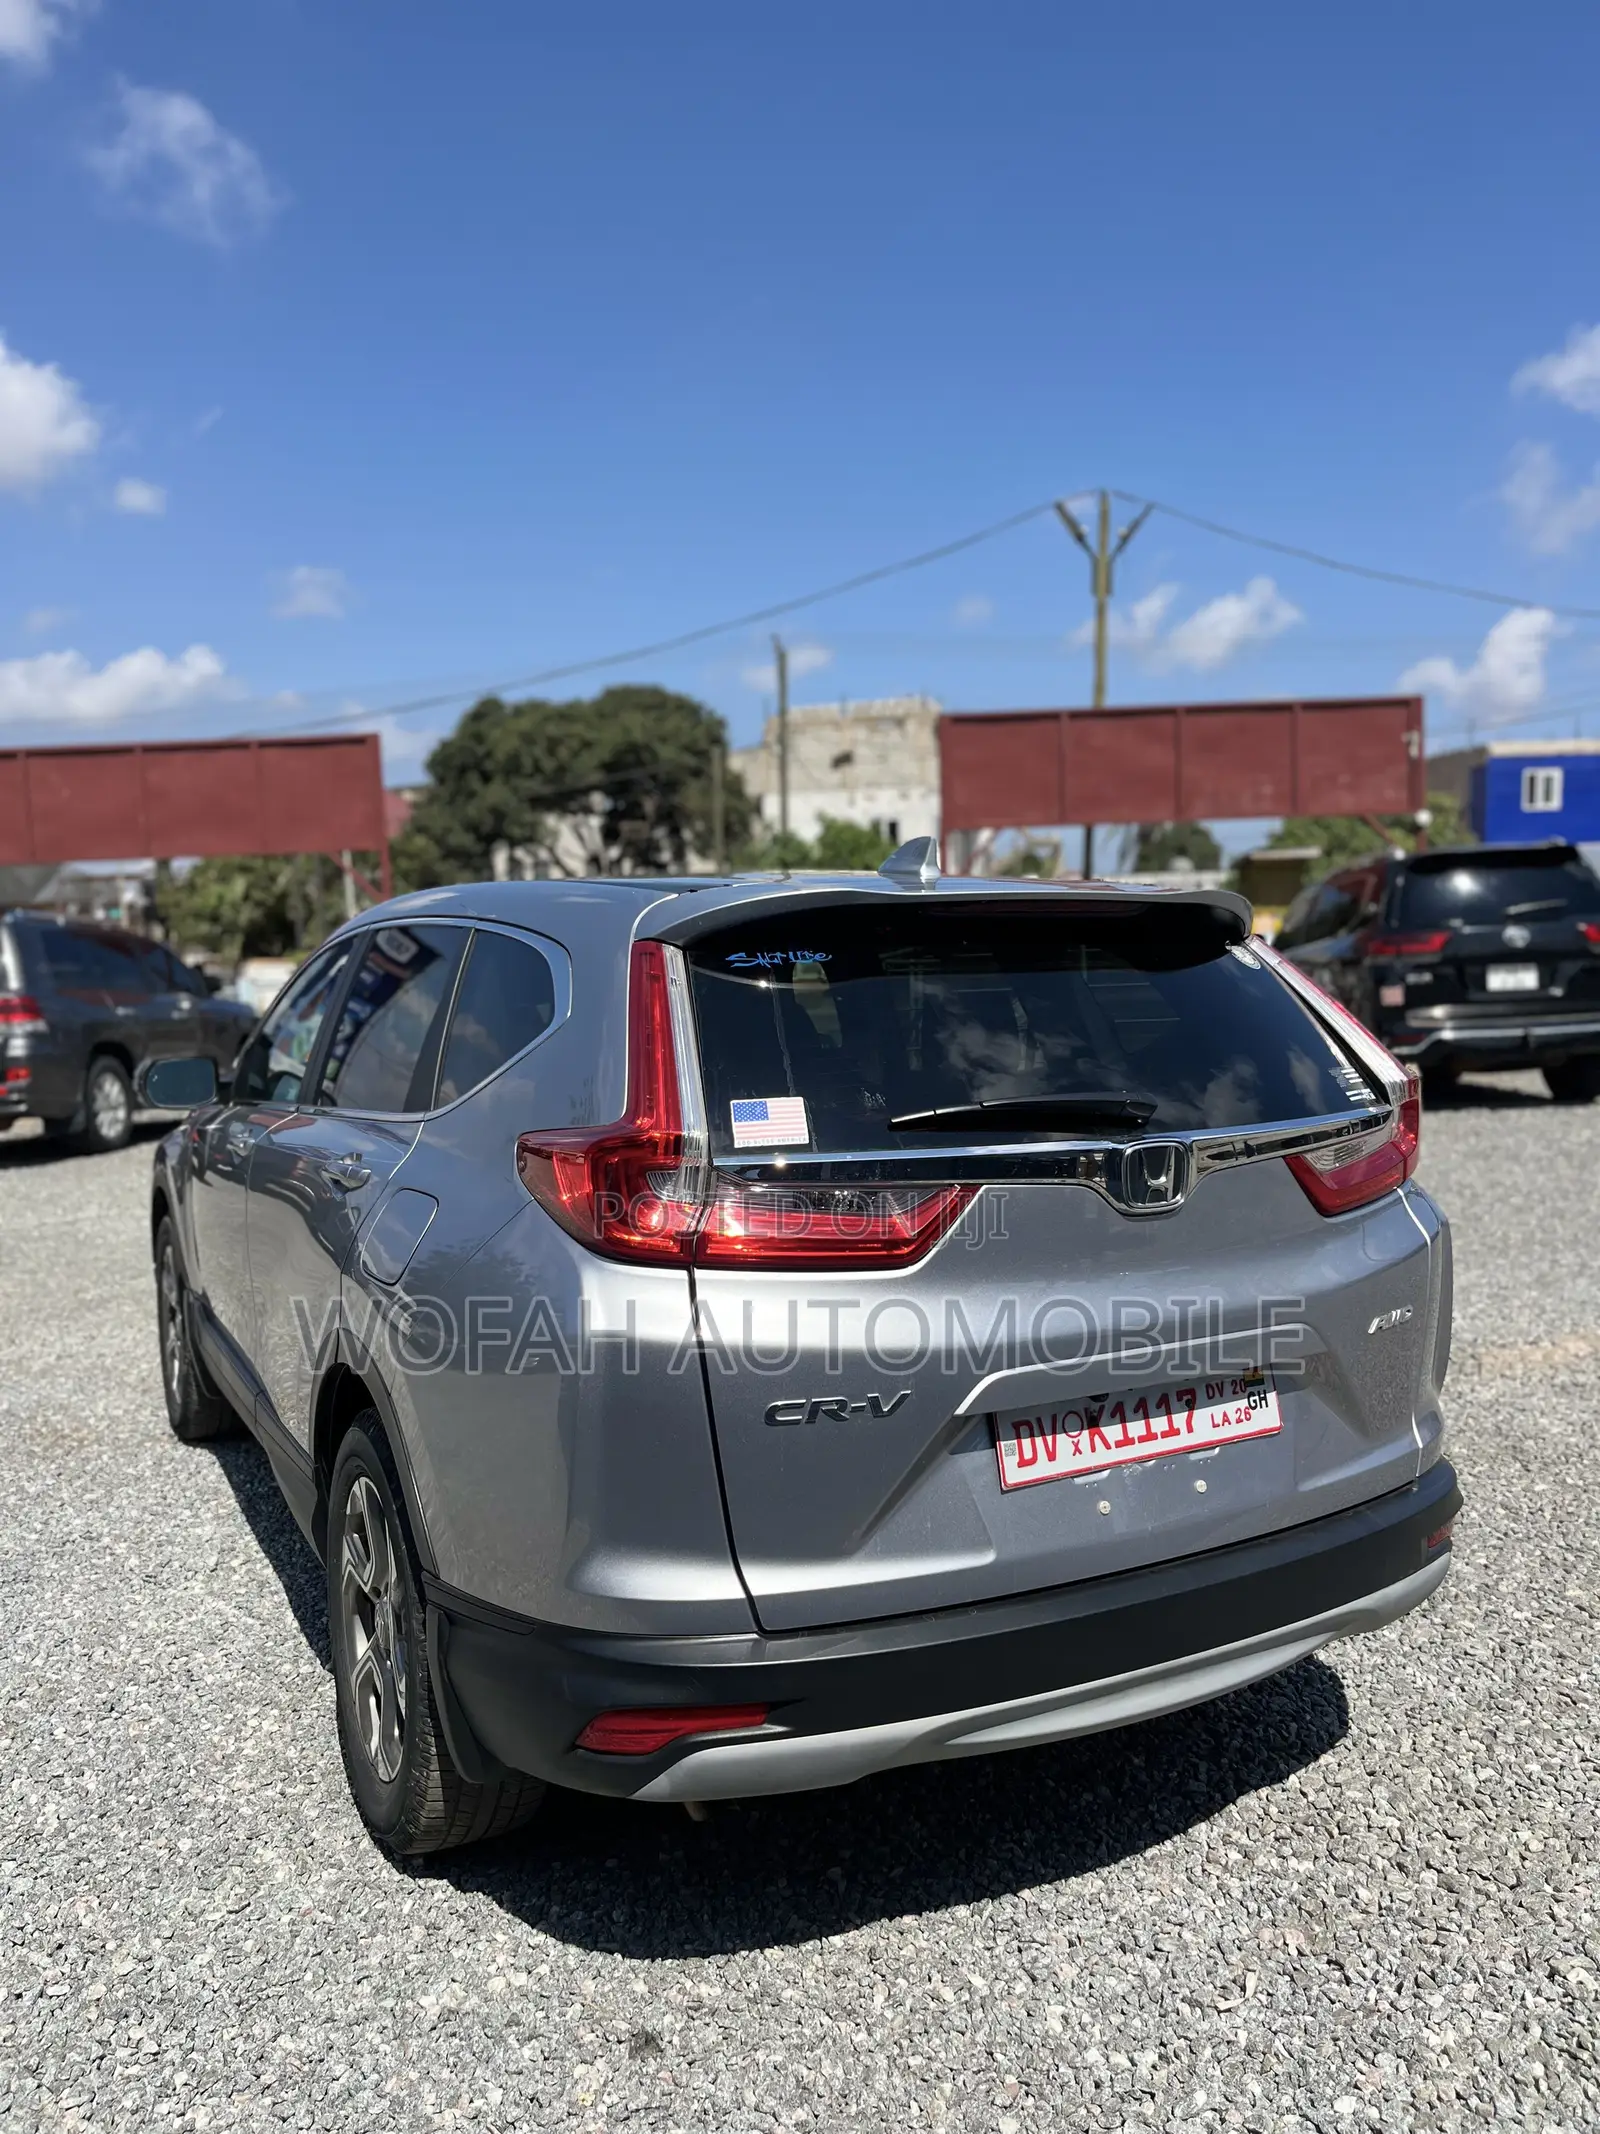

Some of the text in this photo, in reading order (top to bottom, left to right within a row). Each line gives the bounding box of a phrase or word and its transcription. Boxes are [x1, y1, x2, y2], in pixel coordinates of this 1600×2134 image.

[1204, 1378, 1247, 1400] DV 20
[1247, 1389, 1269, 1411] GH
[763, 1389, 912, 1427] CR-V
[1210, 1405, 1252, 1429] LA 26
[1011, 1386, 1197, 1469] DV K1117
